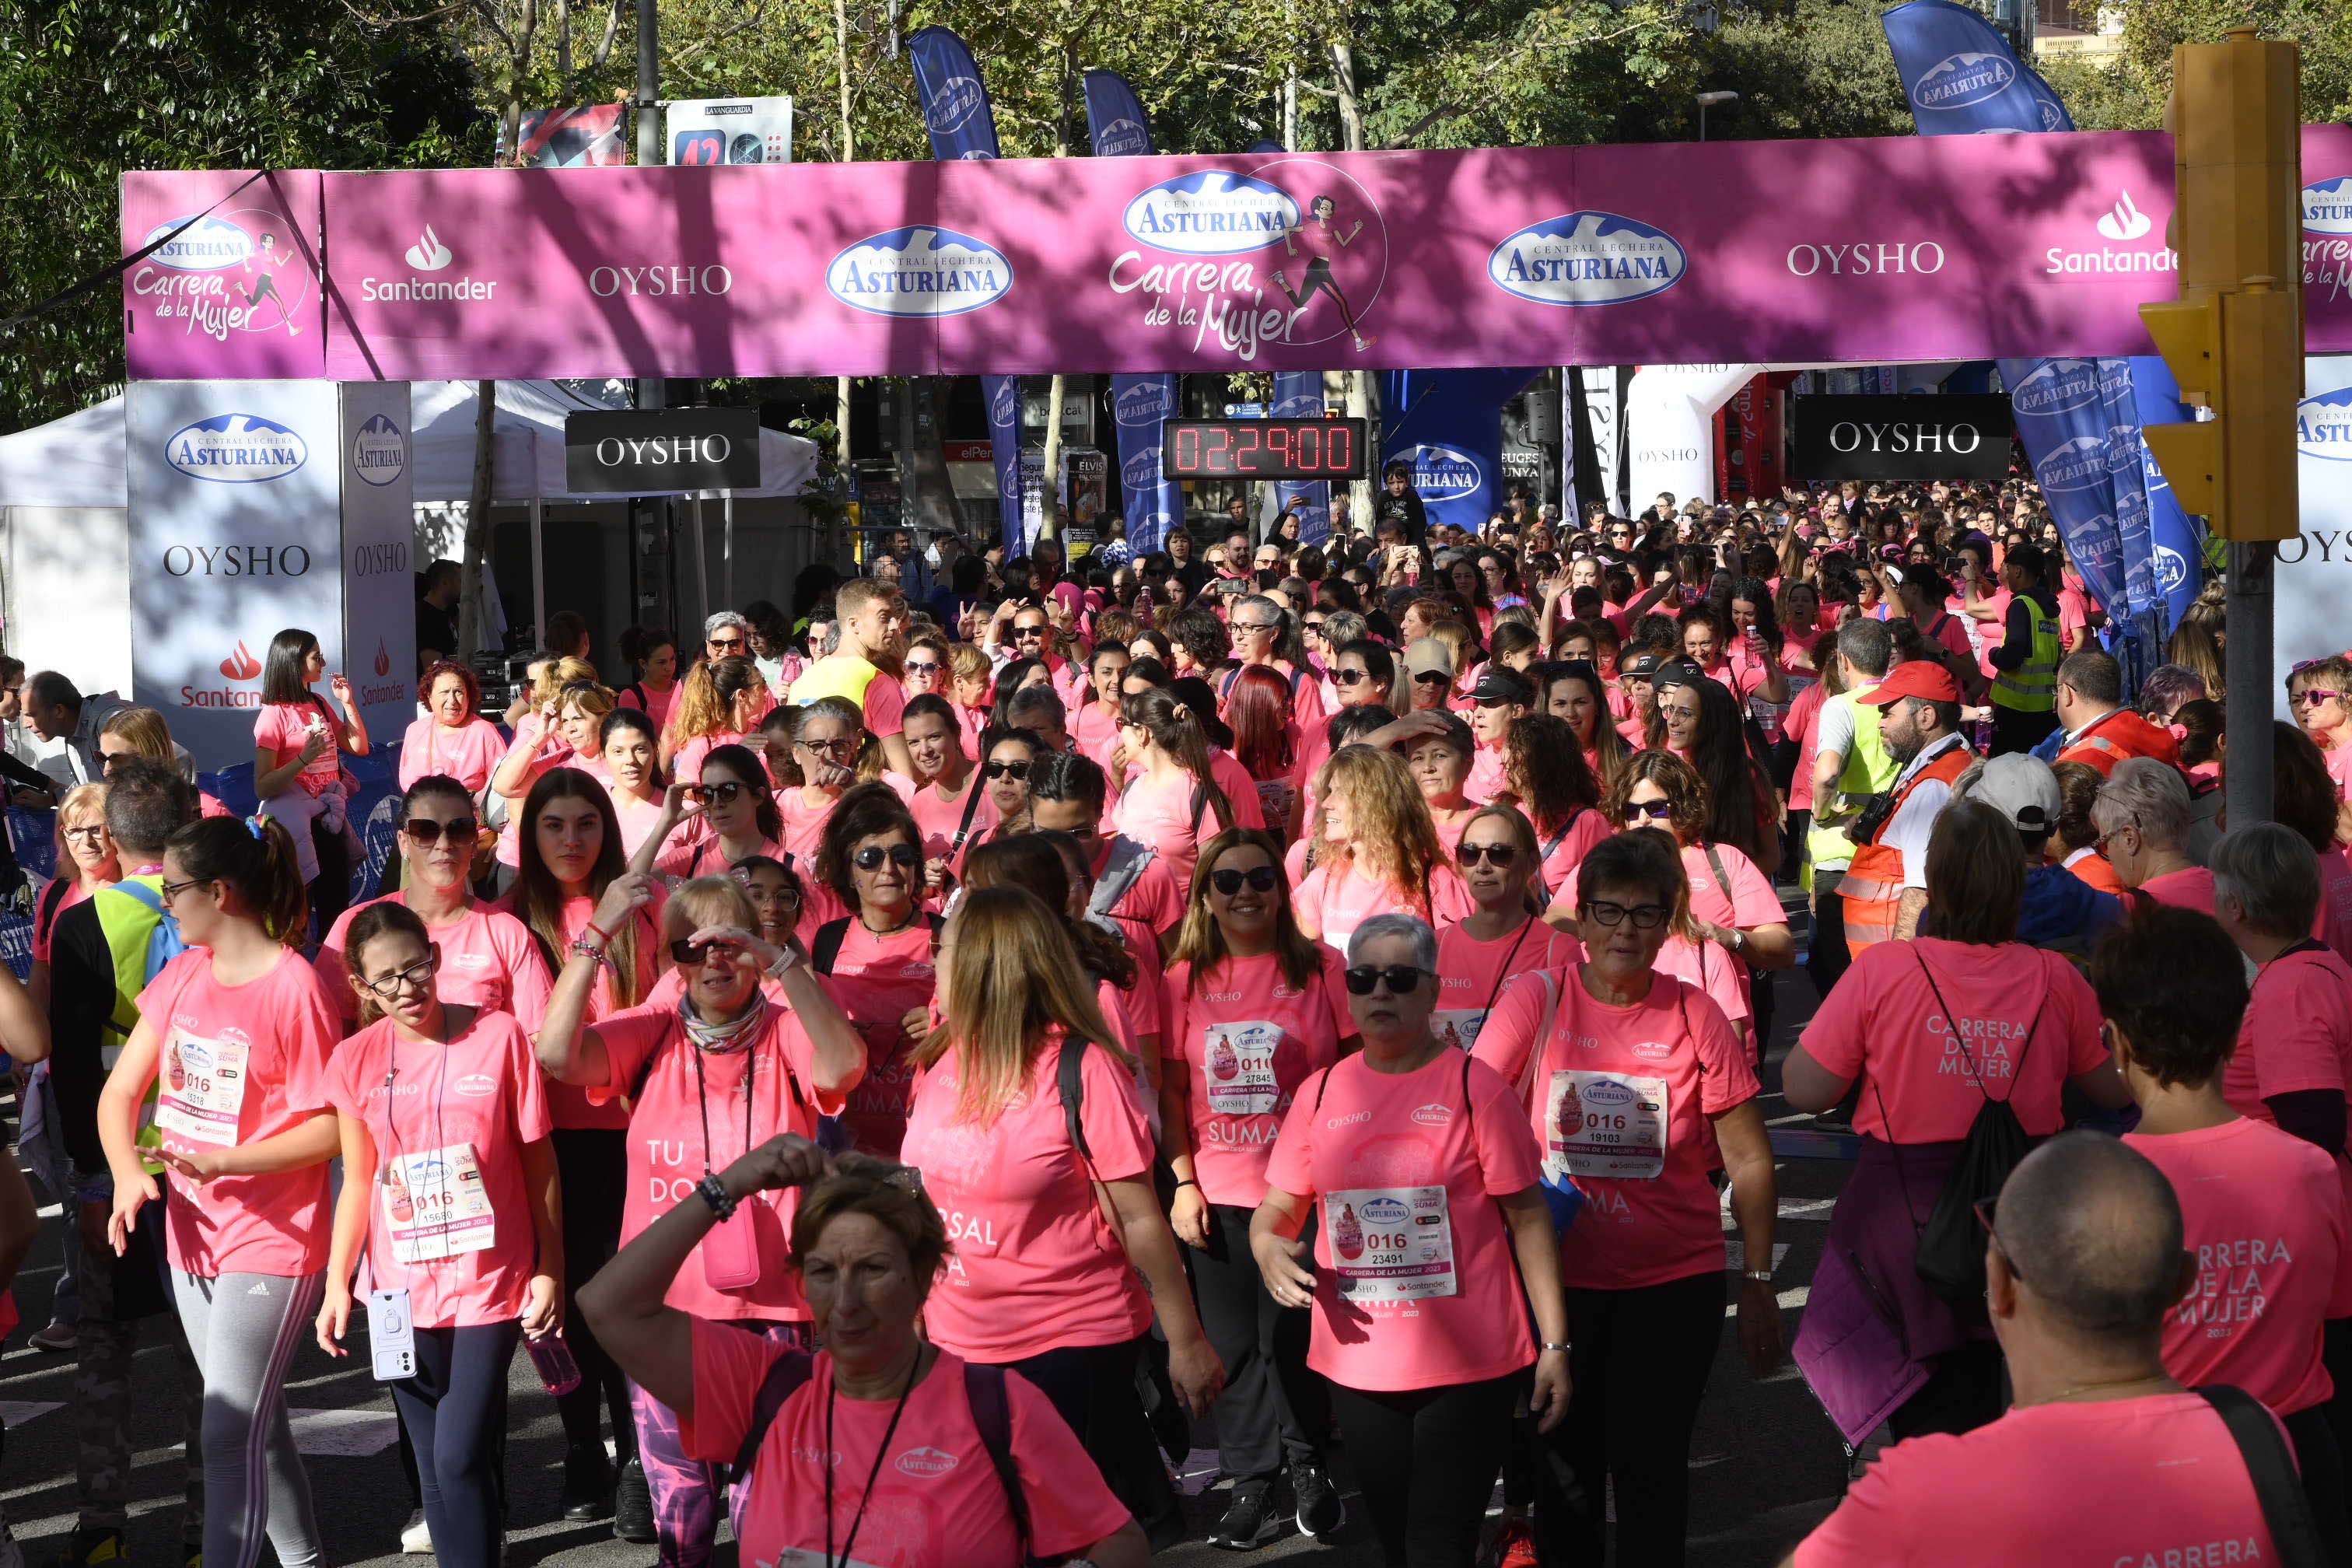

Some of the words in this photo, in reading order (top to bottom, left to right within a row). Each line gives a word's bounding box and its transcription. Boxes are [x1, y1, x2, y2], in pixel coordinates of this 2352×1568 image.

[706, 106, 714, 114] LA
[714, 105, 752, 114] VANGUARDIA
[1138, 202, 1286, 233] ASTURIANA
[1534, 244, 1595, 255] CENTRAL
[1601, 242, 1664, 253] LECHERA
[1787, 241, 1945, 277] OYSHO
[870, 257, 927, 266] CENTRAL
[934, 256, 992, 265] LECHERA
[1503, 247, 1671, 284] ASTURIANA
[2046, 247, 2178, 274] Santande
[133, 266, 224, 296] Carrera
[590, 264, 732, 297] OYSHO
[842, 260, 998, 293] ASTURIANA
[1108, 250, 1255, 293] Carrera
[2319, 263, 2333, 284] la
[362, 276, 497, 302] Santander
[156, 297, 172, 317] de
[177, 297, 188, 317] la
[187, 293, 260, 341] Mujer
[1144, 296, 1171, 327] de
[1178, 296, 1197, 327] la
[1192, 287, 1309, 362] Mujer
[198, 436, 242, 445] CENTRAL
[1829, 422, 1980, 453] OYSHO
[177, 439, 297, 467] ASTURIANA
[357, 439, 403, 469] ASTURIANA
[596, 433, 731, 466] OYSHO
[1177, 428, 1349, 471] 02:29:00
[1501, 452, 1538, 464] EUGES
[1639, 447, 1699, 463] OYSHO
[1079, 461, 1103, 471] ELVIS
[1503, 467, 1538, 478] UNYA
[1410, 472, 1474, 487] URIANA
[163, 545, 310, 576] OYSHO
[355, 542, 406, 578] OYSHO
[181, 686, 262, 708] Santan
[362, 681, 405, 707] Santander
[1927, 1015, 2028, 1039] CARRERA
[1945, 1037, 1972, 1056] DE
[1983, 1040, 2008, 1058] LA
[1937, 1058, 2011, 1078] MUJER
[187, 1073, 211, 1092] 016
[187, 1092, 204, 1106] 15318
[1218, 1099, 1249, 1108] OYSHO
[1587, 1089, 1629, 1101] ASTURIANA
[1328, 1110, 1372, 1130] OYSHO
[1587, 1113, 1626, 1129] 016
[1208, 1121, 1280, 1144] SUMA
[1591, 1132, 1620, 1143] 19103
[647, 1139, 684, 1166] TU
[408, 1167, 451, 1182] ASTURIANA
[416, 1191, 454, 1210] 016
[424, 1210, 453, 1223] 15680
[1363, 1207, 1407, 1218] ASTURIANA
[429, 1227, 438, 1235] DE
[439, 1225, 447, 1234] LA
[449, 1220, 471, 1231] MUJER
[1368, 1234, 1407, 1249] 016
[1373, 1254, 1403, 1265] 23491
[2199, 1237, 2292, 1270] RRERA
[1407, 1280, 1446, 1291] Santander
[2228, 1269, 2263, 1294] LA
[2179, 1296, 2266, 1325] MUJER
[2207, 1328, 2231, 1338] 2023
